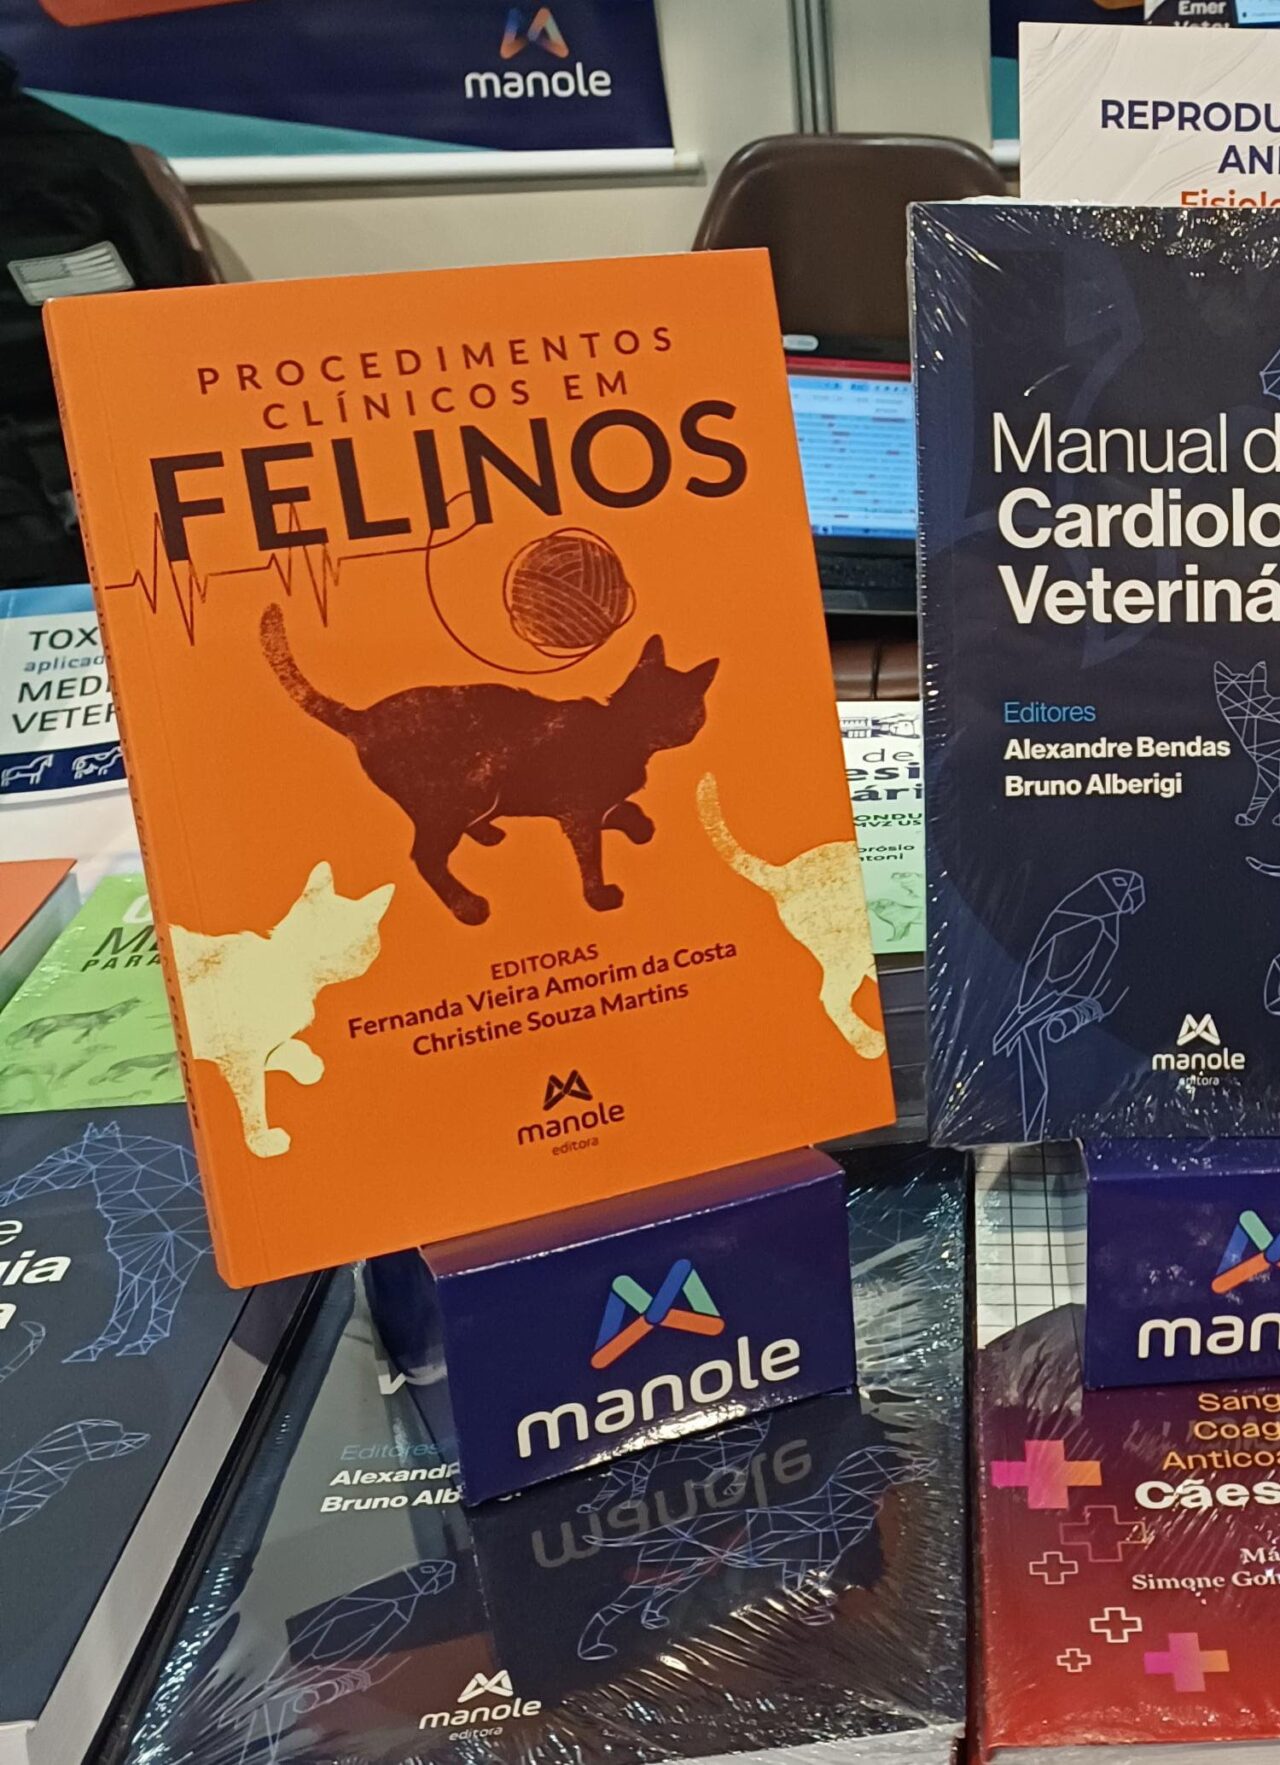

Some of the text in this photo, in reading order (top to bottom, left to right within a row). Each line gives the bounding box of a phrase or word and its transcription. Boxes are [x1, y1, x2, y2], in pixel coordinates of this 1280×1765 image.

[464, 62, 612, 99] manole
[198, 326, 674, 395] PROCEDIMENTOS
[262, 370, 629, 430] CLÍNICOS EM
[992, 412, 1229, 475] Manual
[150, 400, 749, 562] FELINOS
[29, 627, 99, 651] TOX
[1003, 701, 1097, 723] Editores
[862, 748, 915, 763] de
[1003, 736, 1232, 760] Alexandre Bendas
[1005, 772, 1183, 798] Bruno Alberigi
[490, 943, 600, 981] EDITORAS
[348, 940, 738, 1038] Fernanda Vieira Amorim da Costa
[412, 980, 690, 1056] Christine Souza Martins
[1152, 1047, 1246, 1071] manole
[517, 1102, 626, 1145] manole
[552, 1135, 600, 1156] editora
[0, 1250, 71, 1285] ia
[517, 1336, 801, 1458] manole
[320, 1496, 409, 1513] Bruno
[1132, 1571, 1226, 1592] Simone
[419, 1697, 542, 1729] manole
[448, 1726, 504, 1741] editora
